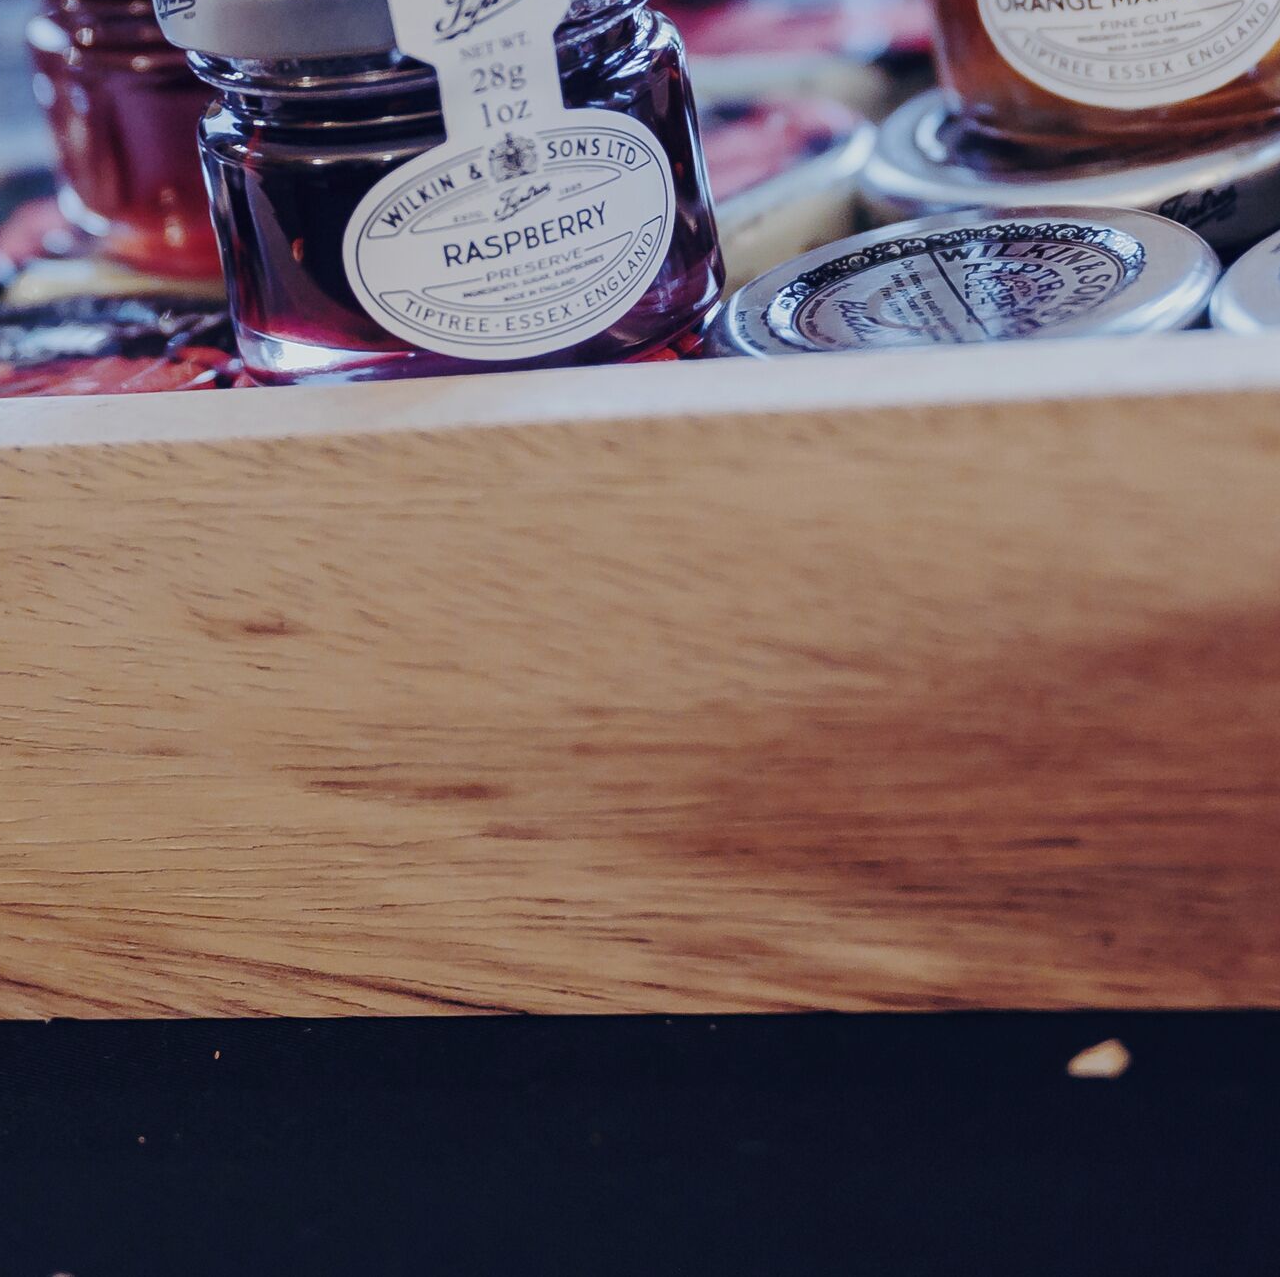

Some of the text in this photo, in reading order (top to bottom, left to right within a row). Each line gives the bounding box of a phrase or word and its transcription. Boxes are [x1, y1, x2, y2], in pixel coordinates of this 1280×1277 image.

[1099, 10, 1179, 31] FINE CUT
[459, 39, 495, 61] NET
[1023, 1, 1271, 81] TIPTREE ESSEX ENGLAND
[472, 62, 529, 95] 28g
[480, 99, 533, 129] 1oz
[380, 138, 637, 229] WILKIN & SONS LTD
[443, 200, 607, 268] RASPBERRY
[485, 246, 584, 282] PRESERVE
[938, 242, 1098, 267] WILKIN
[1071, 260, 1107, 275] &
[403, 231, 655, 334] TIPTREE ESSEX ENGLAND
